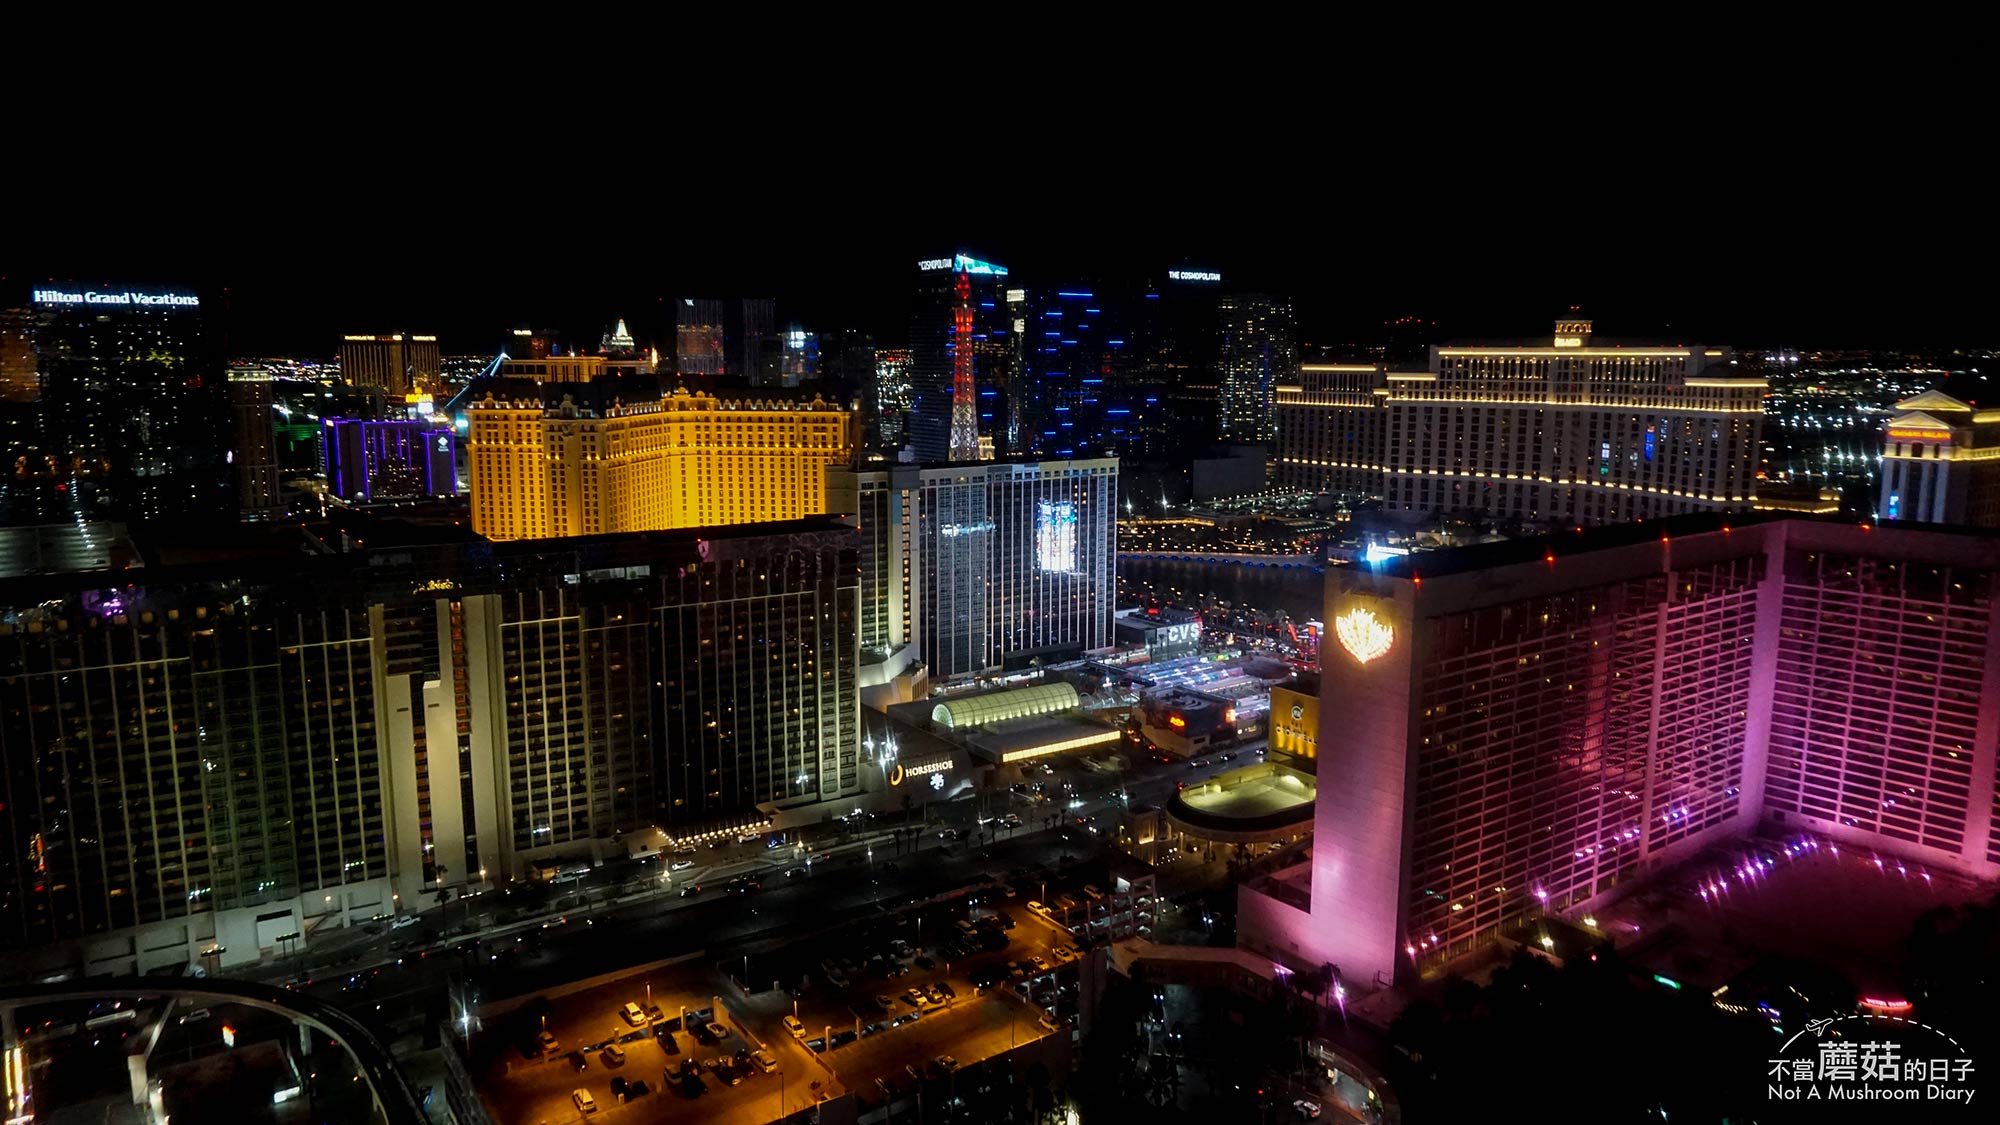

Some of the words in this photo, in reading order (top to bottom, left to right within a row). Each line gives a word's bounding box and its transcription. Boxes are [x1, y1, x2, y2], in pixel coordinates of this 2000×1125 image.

[1168, 270, 1180, 280] THE
[1180, 271, 1221, 281] COSMOPOLITAN
[33, 290, 83, 303] Hilton
[84, 291, 130, 304] Grand
[130, 292, 200, 306] Vacations
[1168, 623, 1200, 642] CVS
[905, 760, 954, 778] HORSESHOE
